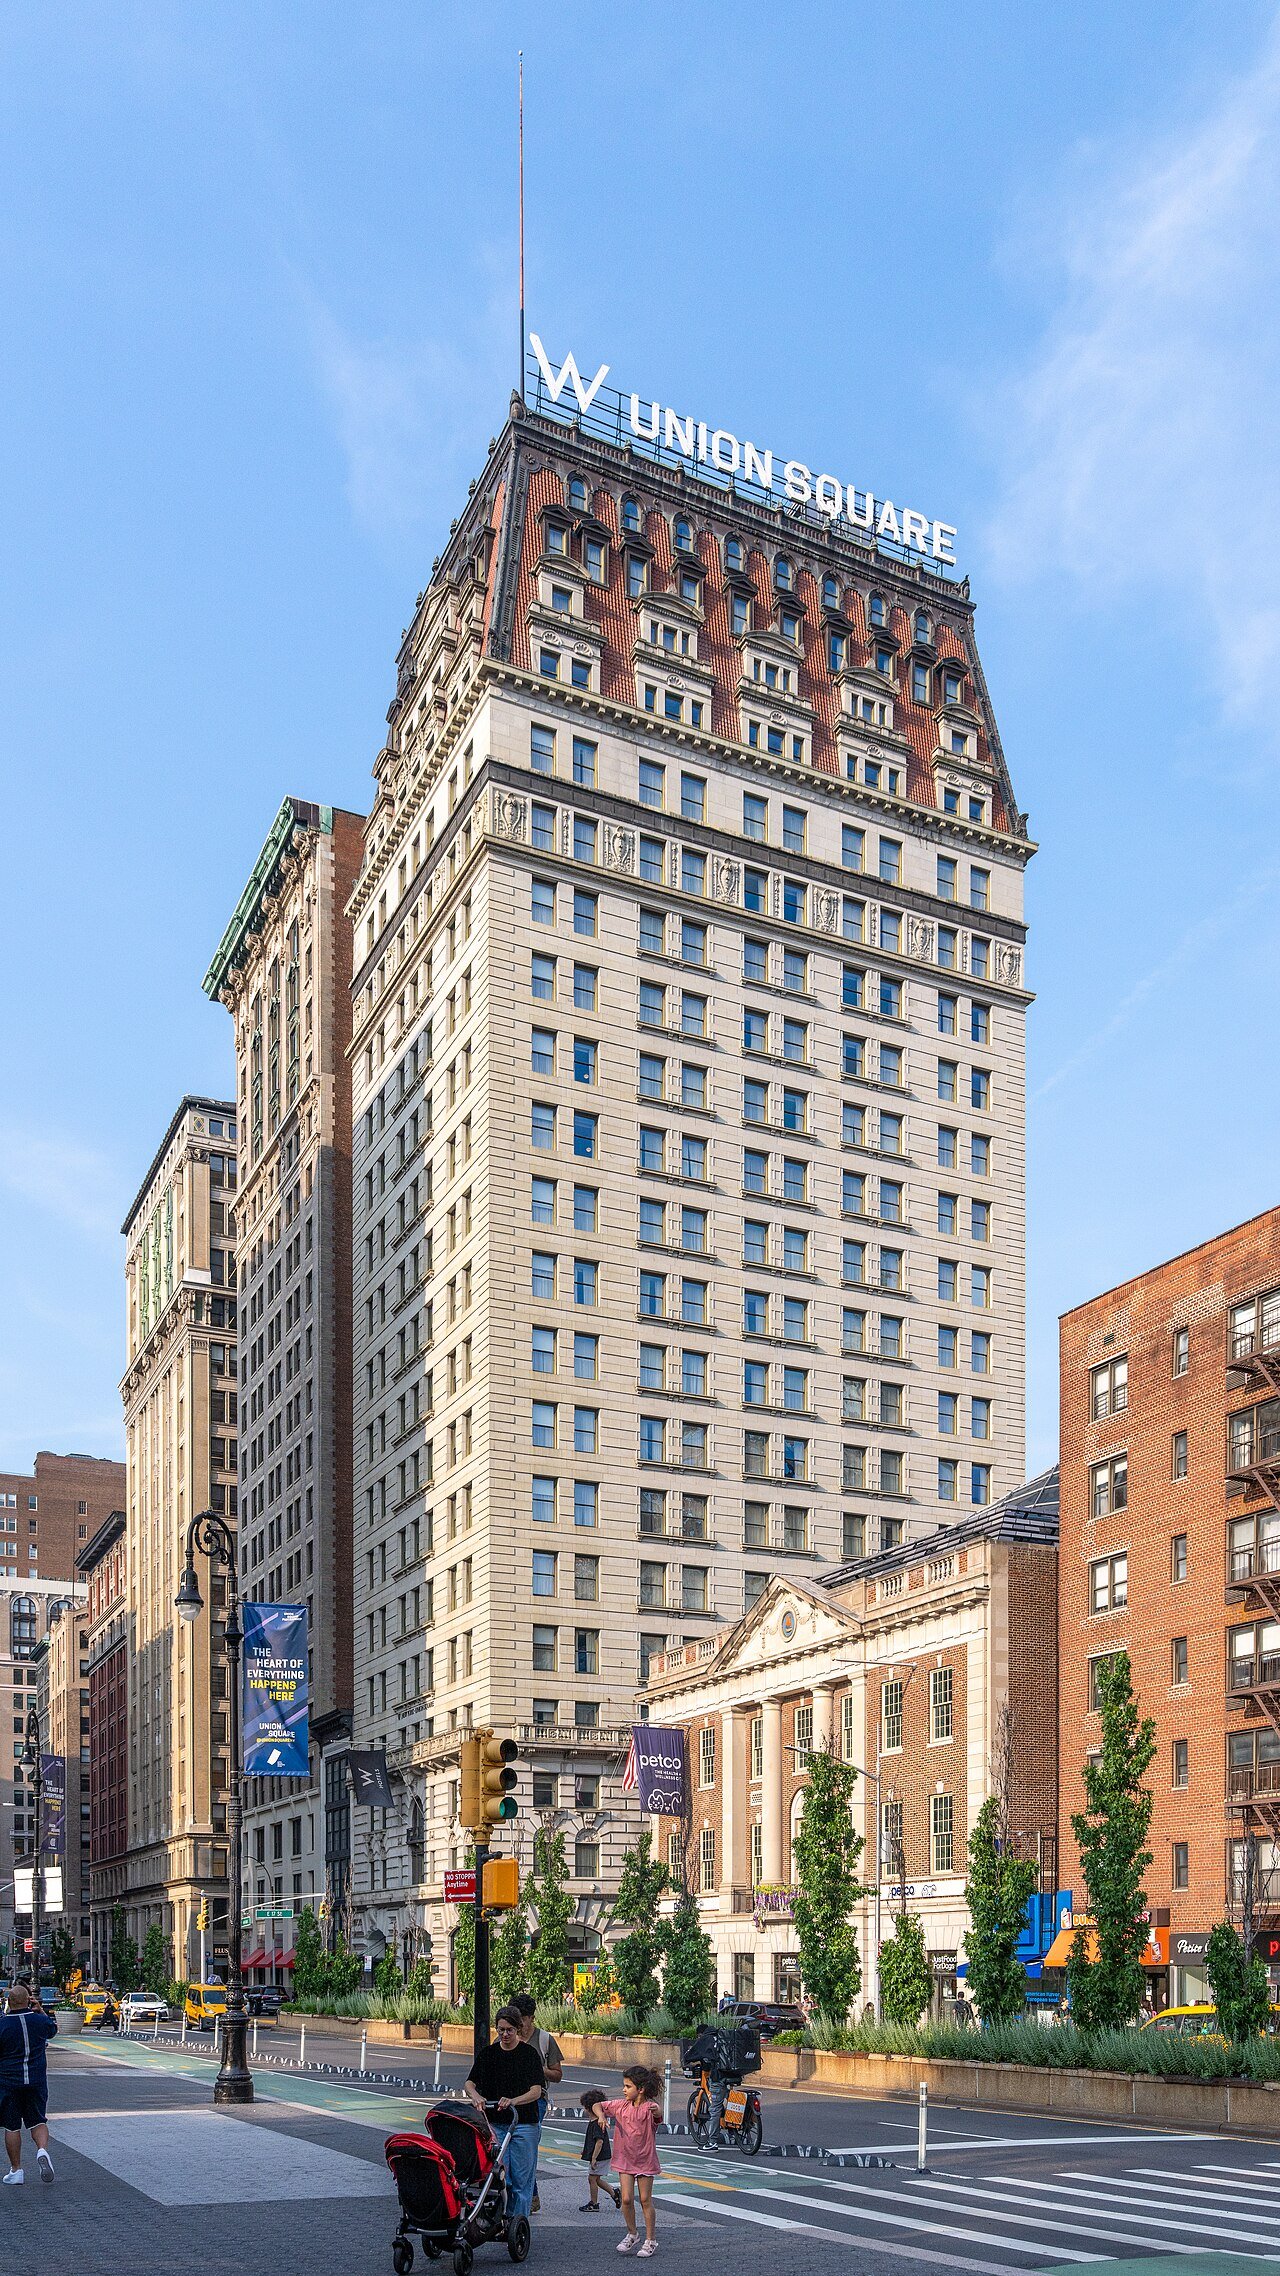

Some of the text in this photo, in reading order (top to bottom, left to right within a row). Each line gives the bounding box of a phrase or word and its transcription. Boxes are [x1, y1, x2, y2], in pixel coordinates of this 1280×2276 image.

[529, 331, 959, 565] W UNION SQUARE
[253, 1647, 271, 1657] THE
[257, 1658, 304, 1669] HEART OF
[247, 1669, 305, 1680] EVERYTHING
[250, 1679, 297, 1690] HAPPENS
[269, 1690, 295, 1701] HERE
[259, 1722, 282, 1730] UNION
[268, 1730, 296, 1738] SQUARE
[639, 1753, 682, 1770] petco
[357, 1767, 375, 1787] W
[374, 1768, 384, 1789] HOTELS
[455, 1872, 476, 1880] STOPPIN
[446, 1880, 469, 1889] Anytime
[891, 1885, 915, 1899] peco
[1177, 1939, 1202, 1955] Petite
[782, 1956, 797, 1967] petco
[931, 1955, 957, 1963] JustFood
[933, 1962, 955, 1971] ForDogs
